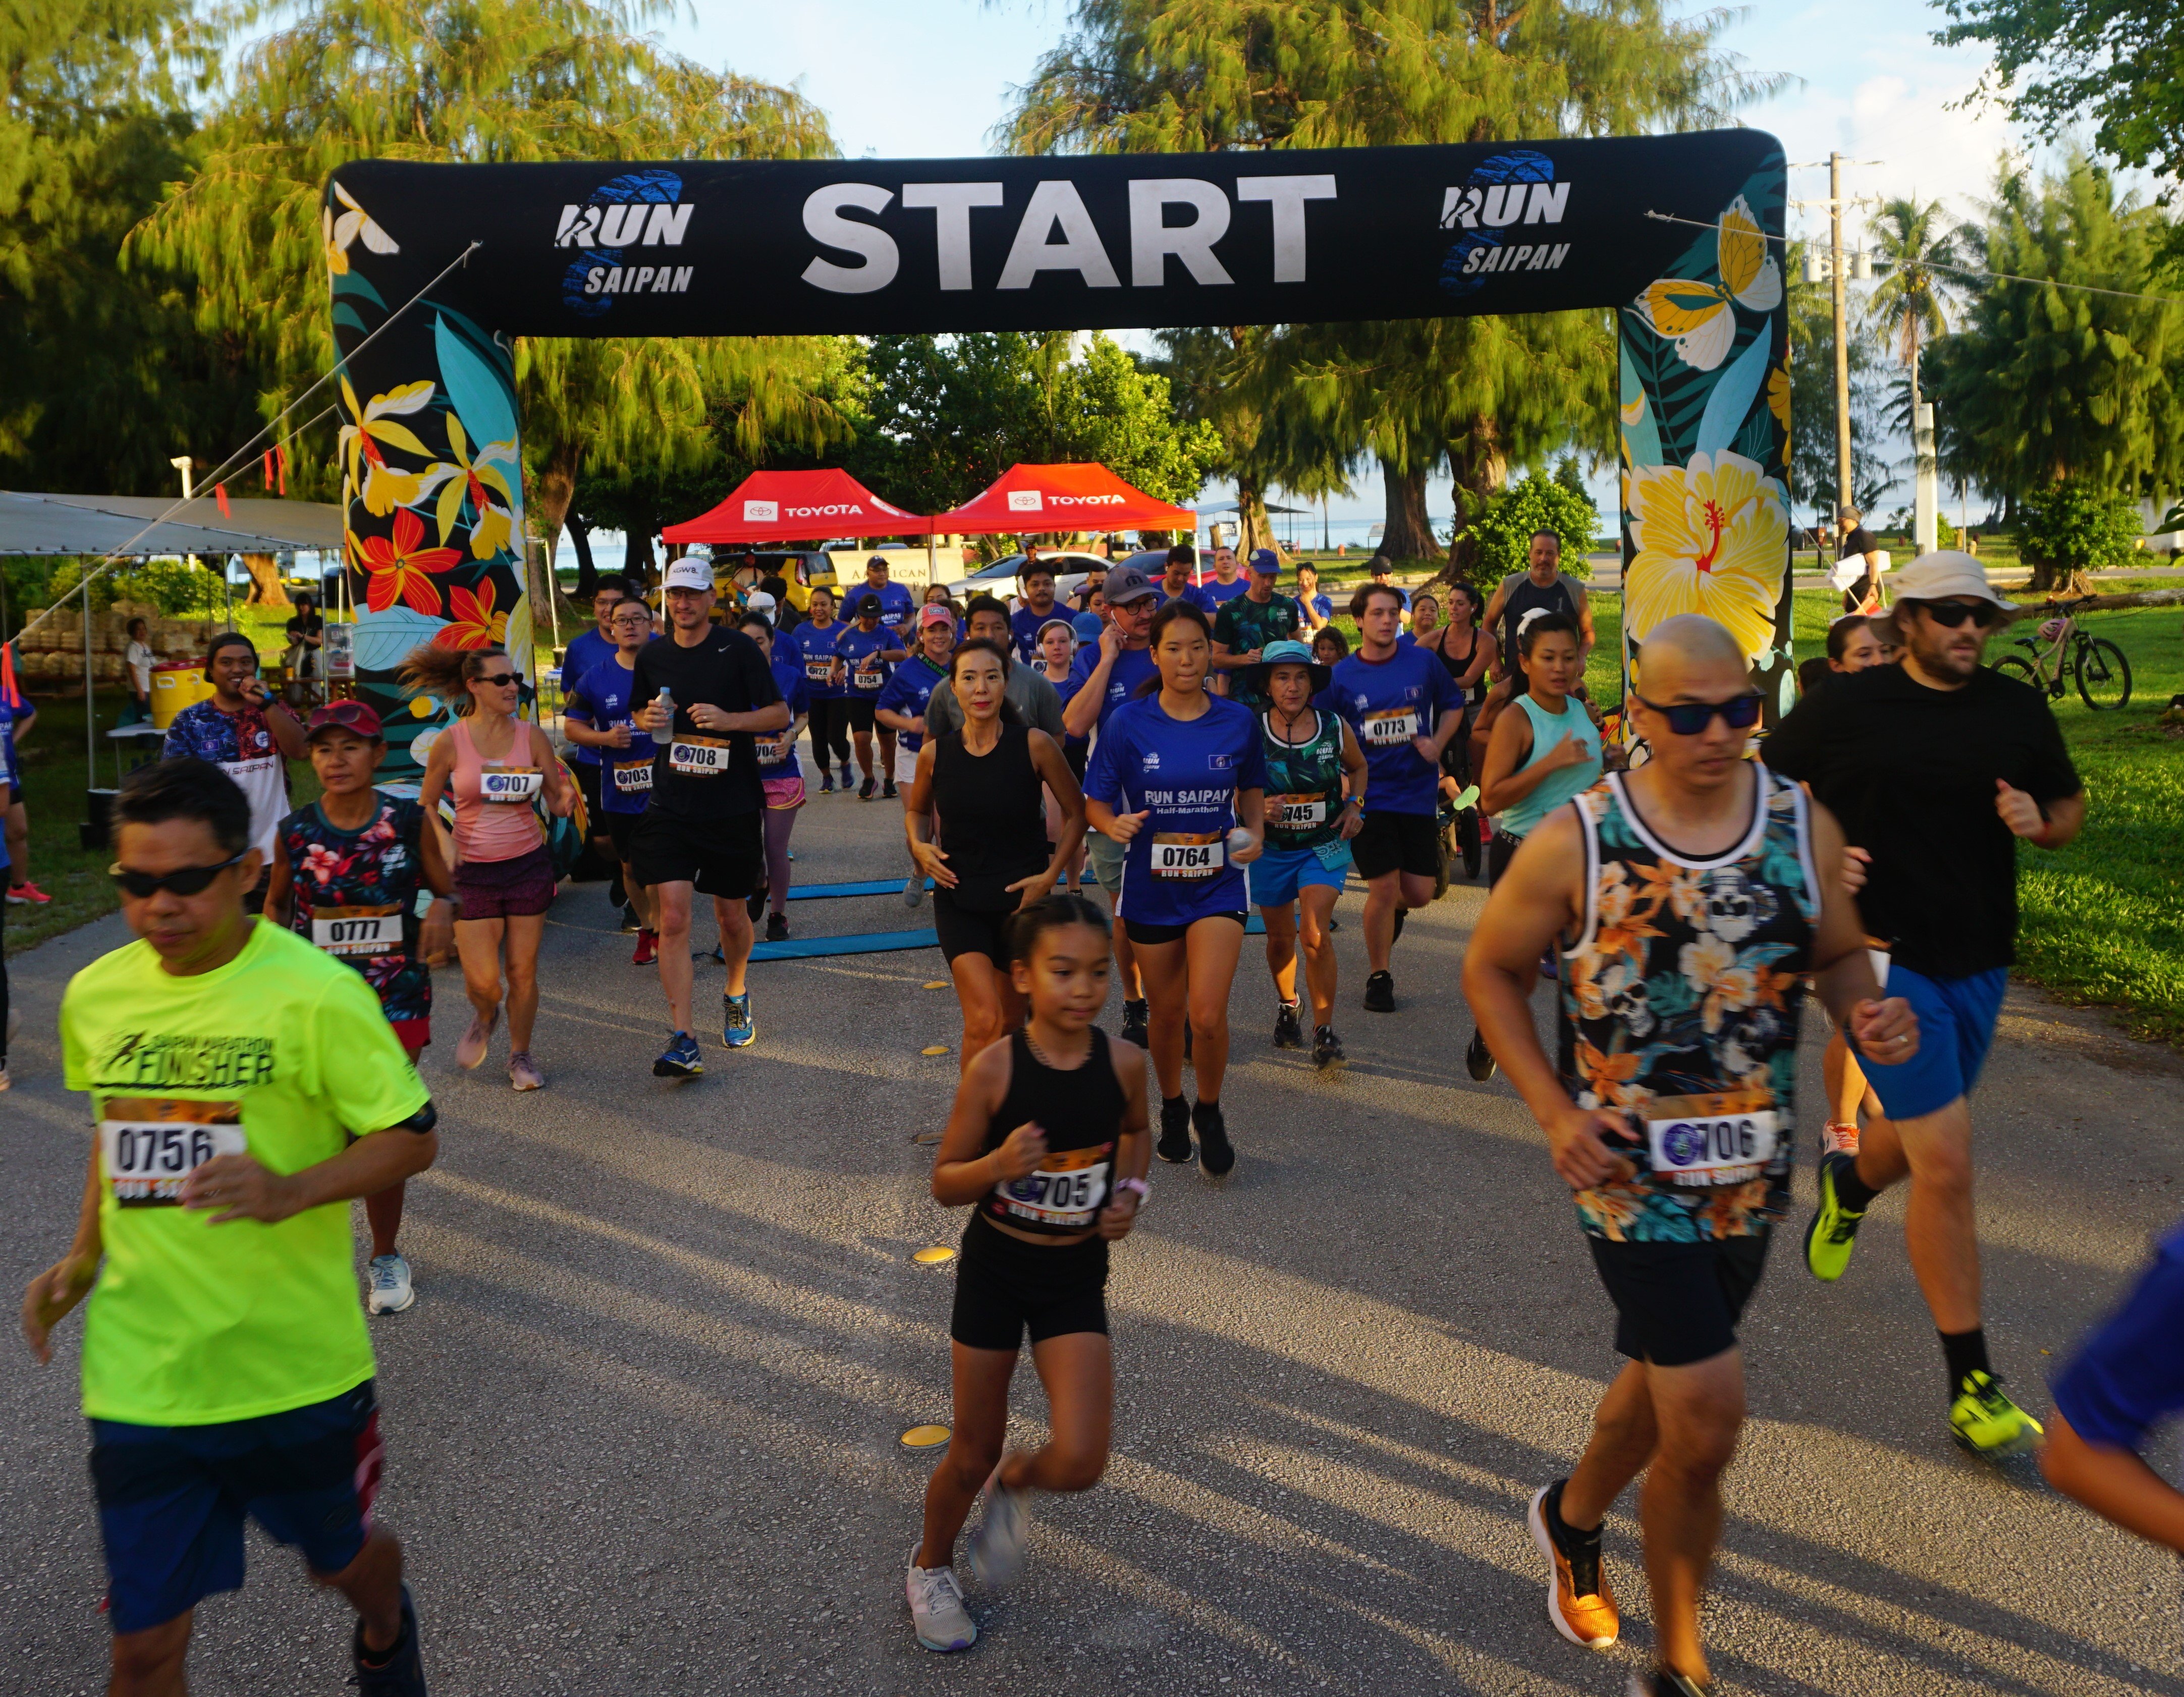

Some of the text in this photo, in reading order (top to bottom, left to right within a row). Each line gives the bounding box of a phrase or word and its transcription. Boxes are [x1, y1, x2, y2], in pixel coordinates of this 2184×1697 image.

[1440, 182, 1571, 229] RUN
[554, 204, 694, 247] RUN
[801, 174, 1337, 294] START
[1463, 244, 1571, 273] SAIPAN
[585, 266, 693, 293] SAIPAN
[1048, 494, 1125, 505] TOYOTA
[785, 505, 863, 517] TOYOTA
[1374, 719, 1406, 736] 0773
[689, 747, 716, 765] 708
[233, 761, 274, 775] SAIPAN
[626, 769, 648, 784] 703
[677, 764, 718, 775] RUN SAIPAN
[503, 776, 529, 792] 707
[1145, 790, 1173, 804] RUN
[1157, 806, 1219, 814] Half-Marathon
[1285, 804, 1314, 822] 745
[1291, 822, 1317, 830] SAIPAN
[1163, 847, 1210, 867] 0764
[1182, 869, 1213, 878] SAIPAN
[331, 920, 380, 942] 0777
[137, 1050, 274, 1084] FINISHER
[1695, 1119, 1755, 1161] 706
[119, 1128, 213, 1171] 0756
[1038, 1173, 1090, 1208] 705
